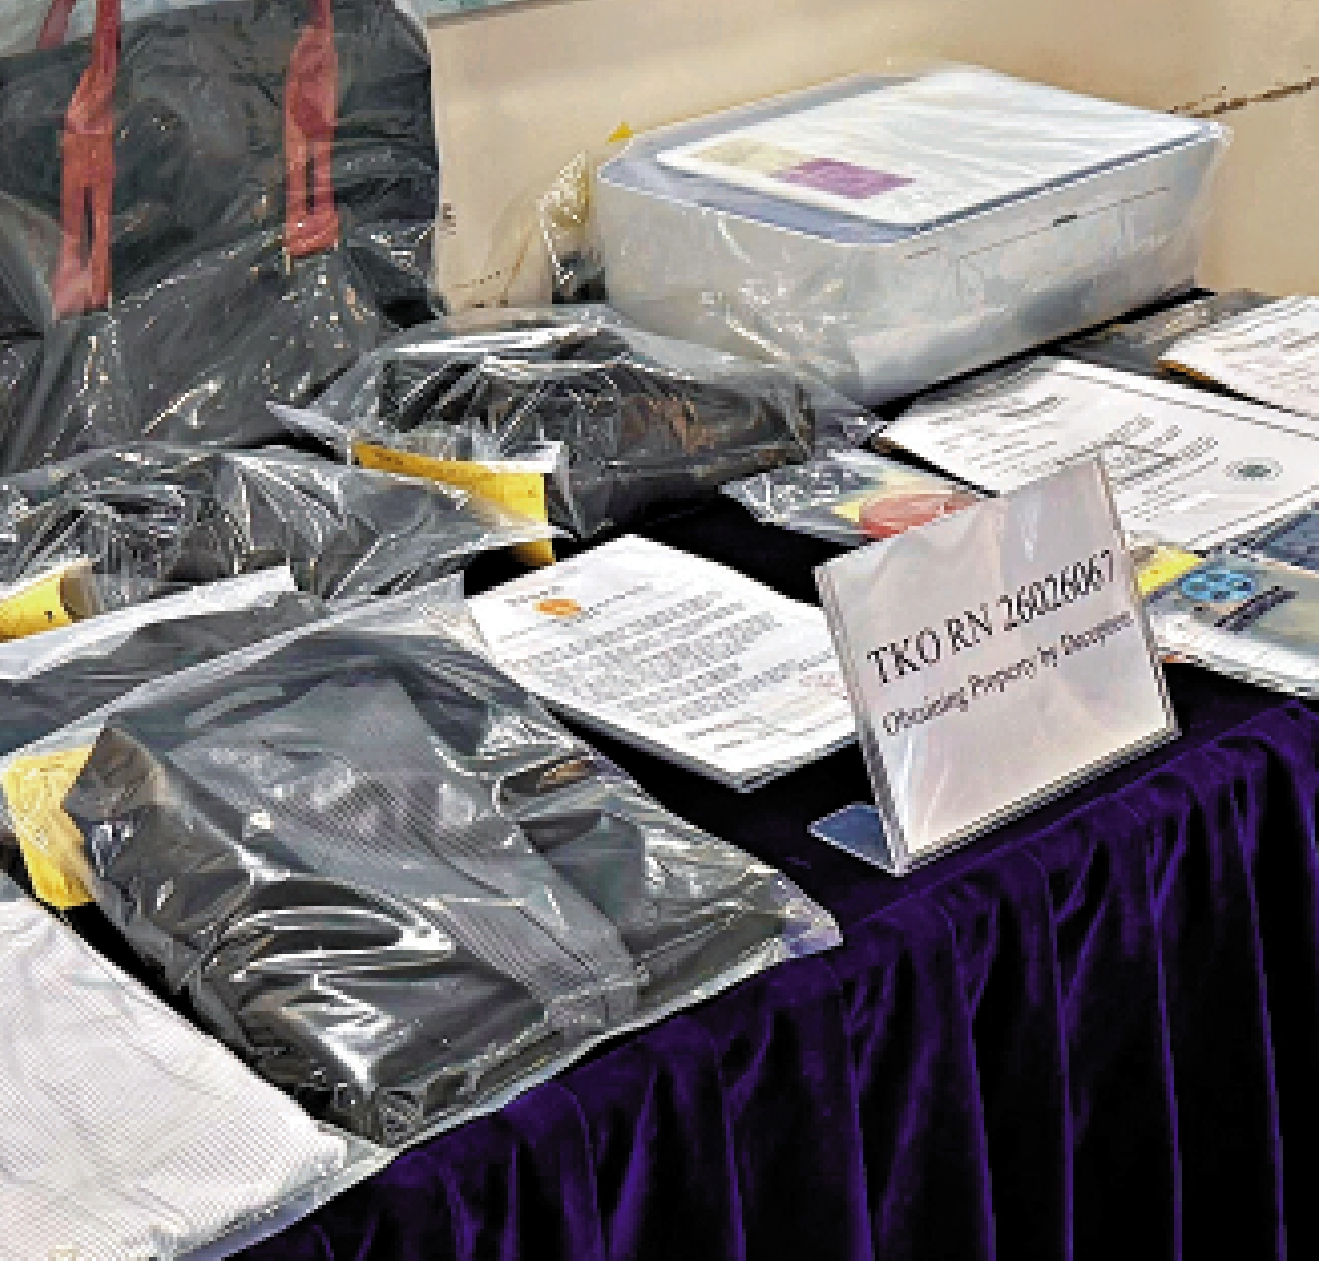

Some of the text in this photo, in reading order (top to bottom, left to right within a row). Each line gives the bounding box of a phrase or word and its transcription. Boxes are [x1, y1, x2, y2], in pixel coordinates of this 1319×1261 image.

[866, 549, 1115, 684] TKO RN 26026067
[882, 687, 969, 737] Obtaining
[968, 657, 1038, 697] Property
[1036, 645, 1059, 668] by
